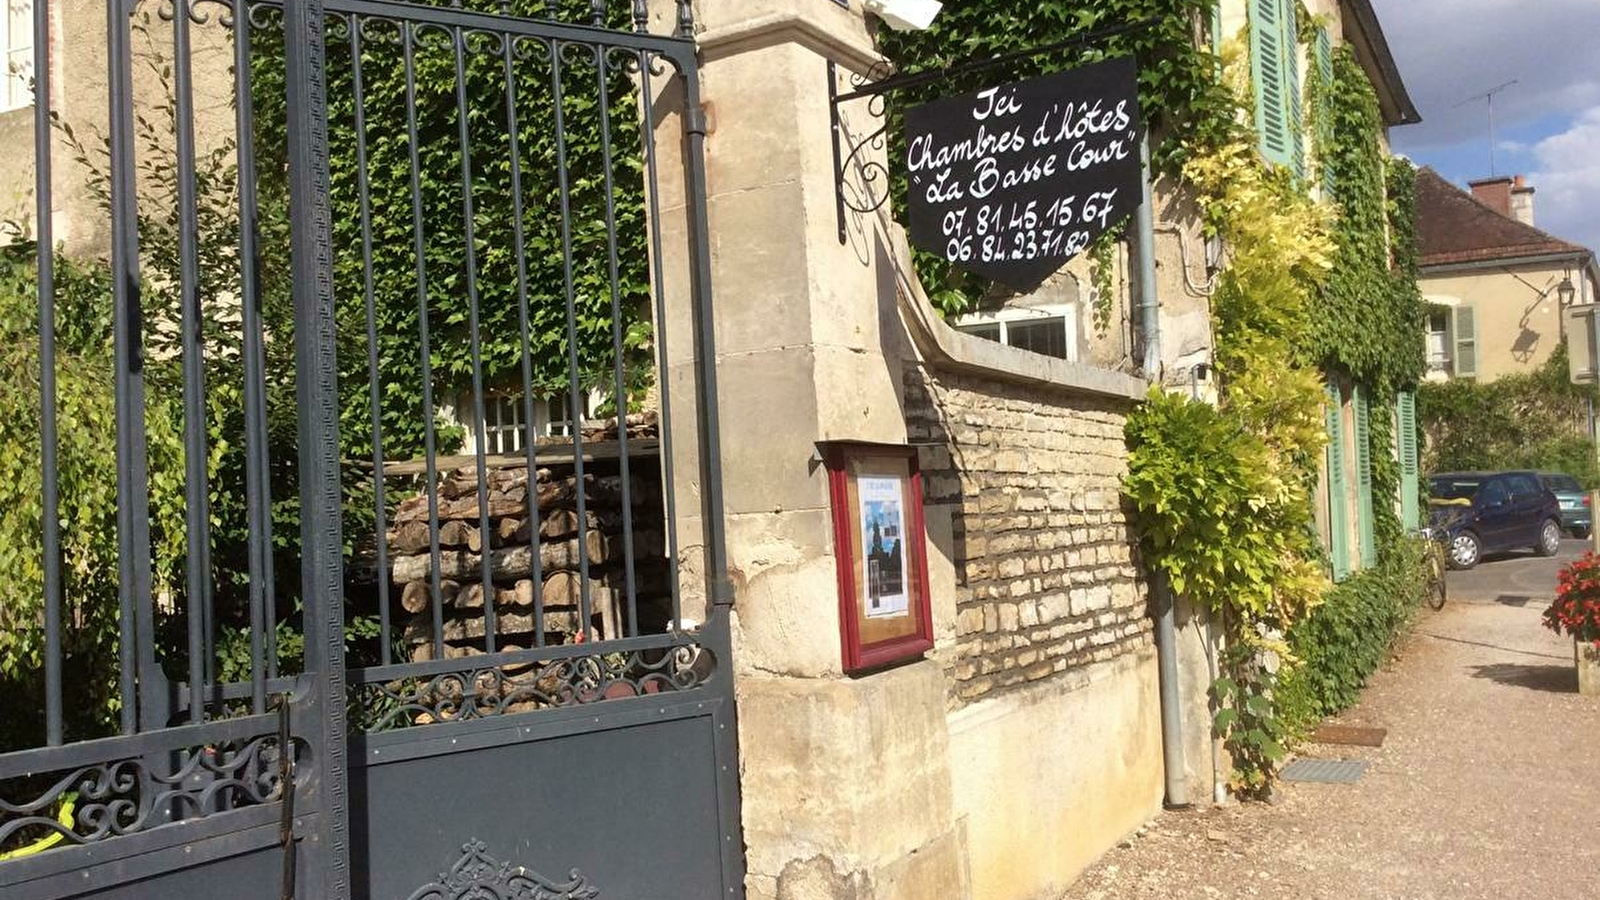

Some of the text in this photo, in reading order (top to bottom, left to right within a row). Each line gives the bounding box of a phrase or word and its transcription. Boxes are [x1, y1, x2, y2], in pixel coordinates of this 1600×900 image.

[907, 98, 1131, 172] Chambres d'hôtes
[969, 157, 1056, 198] Basse
